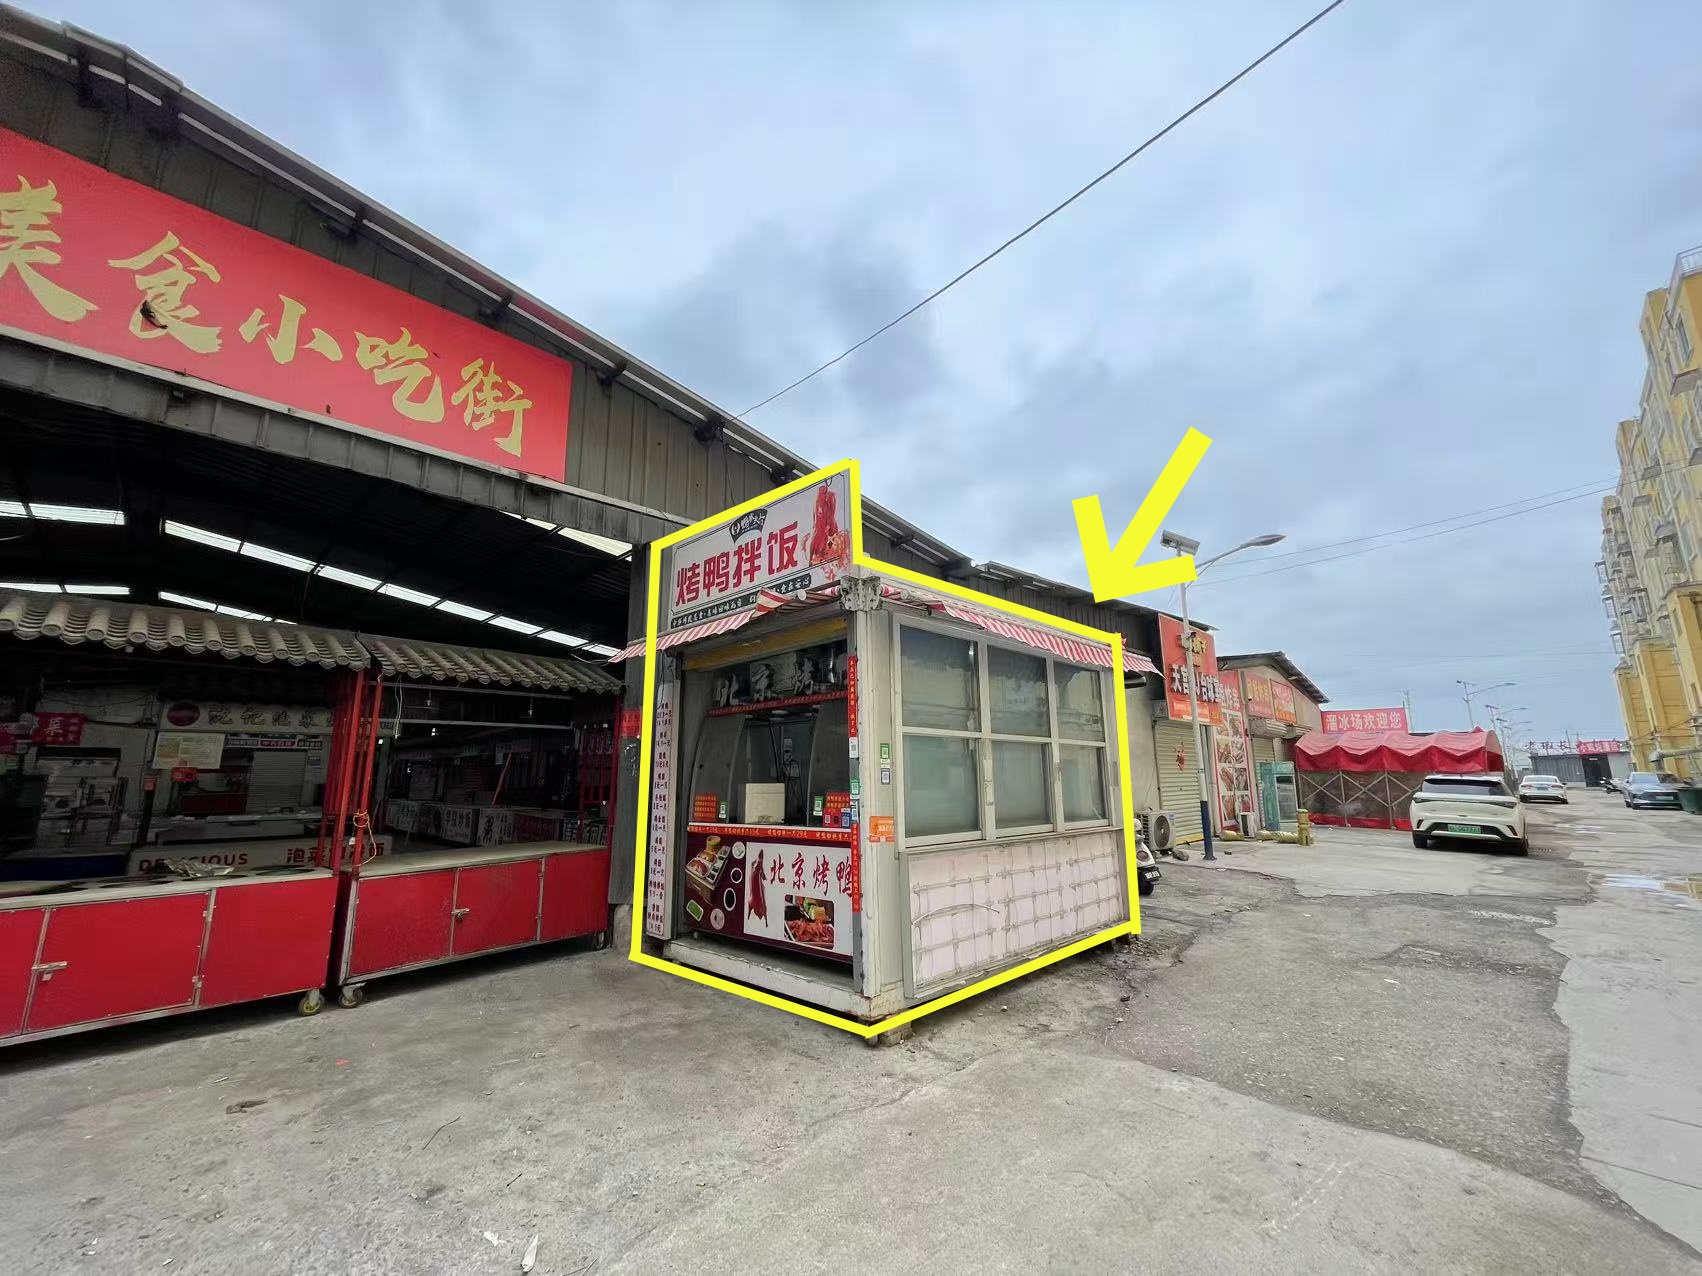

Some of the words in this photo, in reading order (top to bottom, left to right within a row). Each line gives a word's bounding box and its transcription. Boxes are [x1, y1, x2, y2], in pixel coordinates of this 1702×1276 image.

[0, 175, 534, 457] 美食小吃街
[675, 520, 799, 606] 烤鸭拌饭
[770, 852, 853, 898] 北京烤鸭
